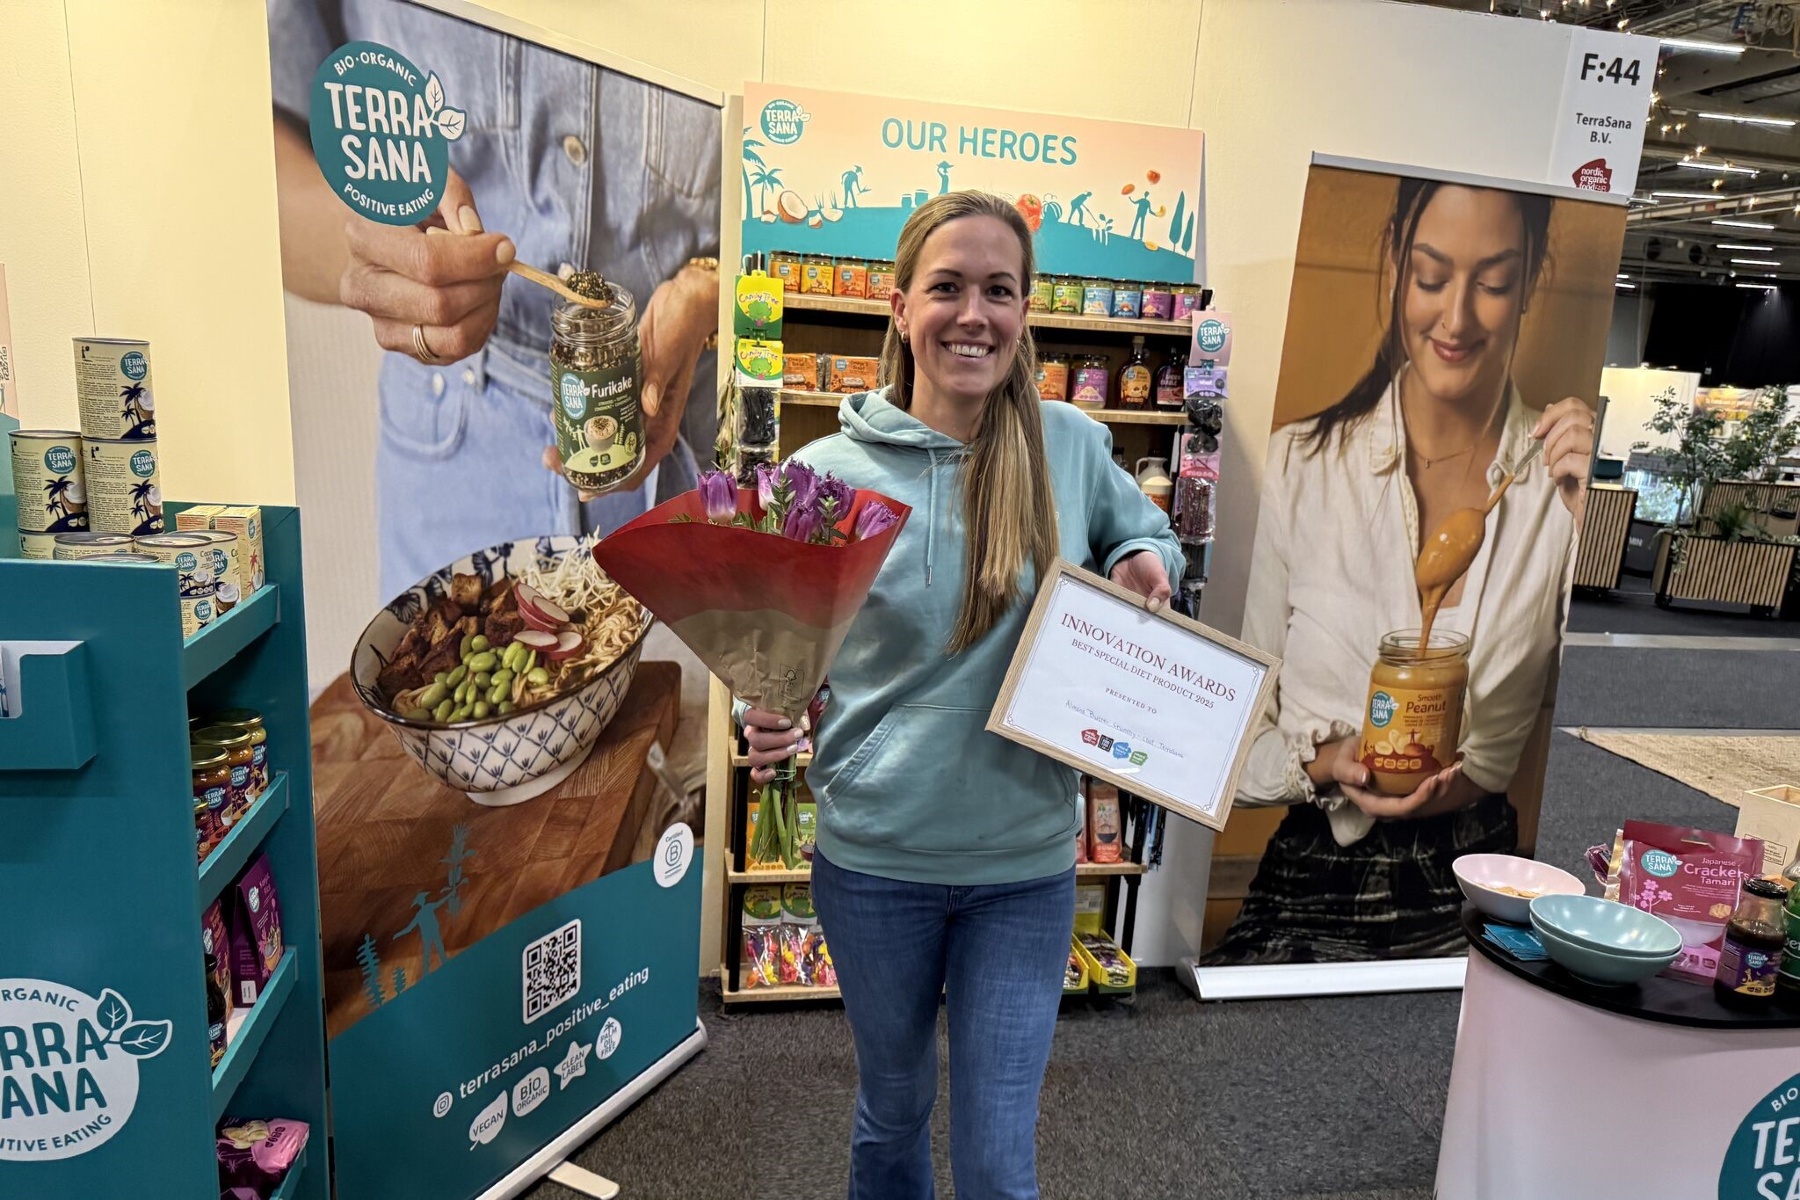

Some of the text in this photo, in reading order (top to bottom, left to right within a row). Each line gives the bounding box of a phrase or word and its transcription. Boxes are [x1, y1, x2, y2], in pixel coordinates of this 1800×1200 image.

[1580, 53, 1641, 86] F:44
[323, 81, 434, 138] TERRA
[765, 109, 800, 122] TERRA
[768, 121, 798, 135] SANA
[1576, 112, 1632, 130] TerraSana
[881, 117, 1079, 167] OUR HEROES
[1590, 131, 1612, 144] B.V.
[341, 134, 432, 184] SANA
[1580, 175, 1608, 185] organic
[1581, 167, 1604, 177] nordic
[343, 182, 435, 217] POSITIVE EATING
[1200, 325, 1222, 337] TERRA
[1202, 335, 1221, 345] SANA
[124, 357, 146, 367] TERRA
[127, 366, 145, 375] SANA
[562, 376, 633, 398] TERRA Furikake
[565, 395, 583, 409] SANA
[47, 452, 73, 462] TERRA
[51, 459, 73, 469] SANA
[1061, 612, 1236, 702] INNOVATION AWARDS
[1071, 638, 1214, 709] BEST SPECIAL DIET PRODUCT 2025
[1105, 687, 1157, 714] PRESENTED TO
[1372, 694, 1442, 710] TERRA Smooth
[1405, 700, 1446, 713] Peanut
[1372, 708, 1388, 719] SANA
[1645, 854, 1736, 866] TERRA Japanese
[1648, 862, 1750, 879] SANA Crackers
[1701, 876, 1736, 886] Tamari
[0, 987, 80, 1013] RGANIC
[459, 967, 649, 1099] terrasana_positive_eating
[0, 1018, 109, 1071] RRA
[561, 1050, 585, 1071] CLEAN
[562, 1060, 584, 1080] LABEL
[1, 1067, 107, 1119] ANA
[516, 1085, 548, 1112] ORGANIC
[52, 1113, 112, 1149] EATING
[472, 1109, 504, 1138] VEGAN
